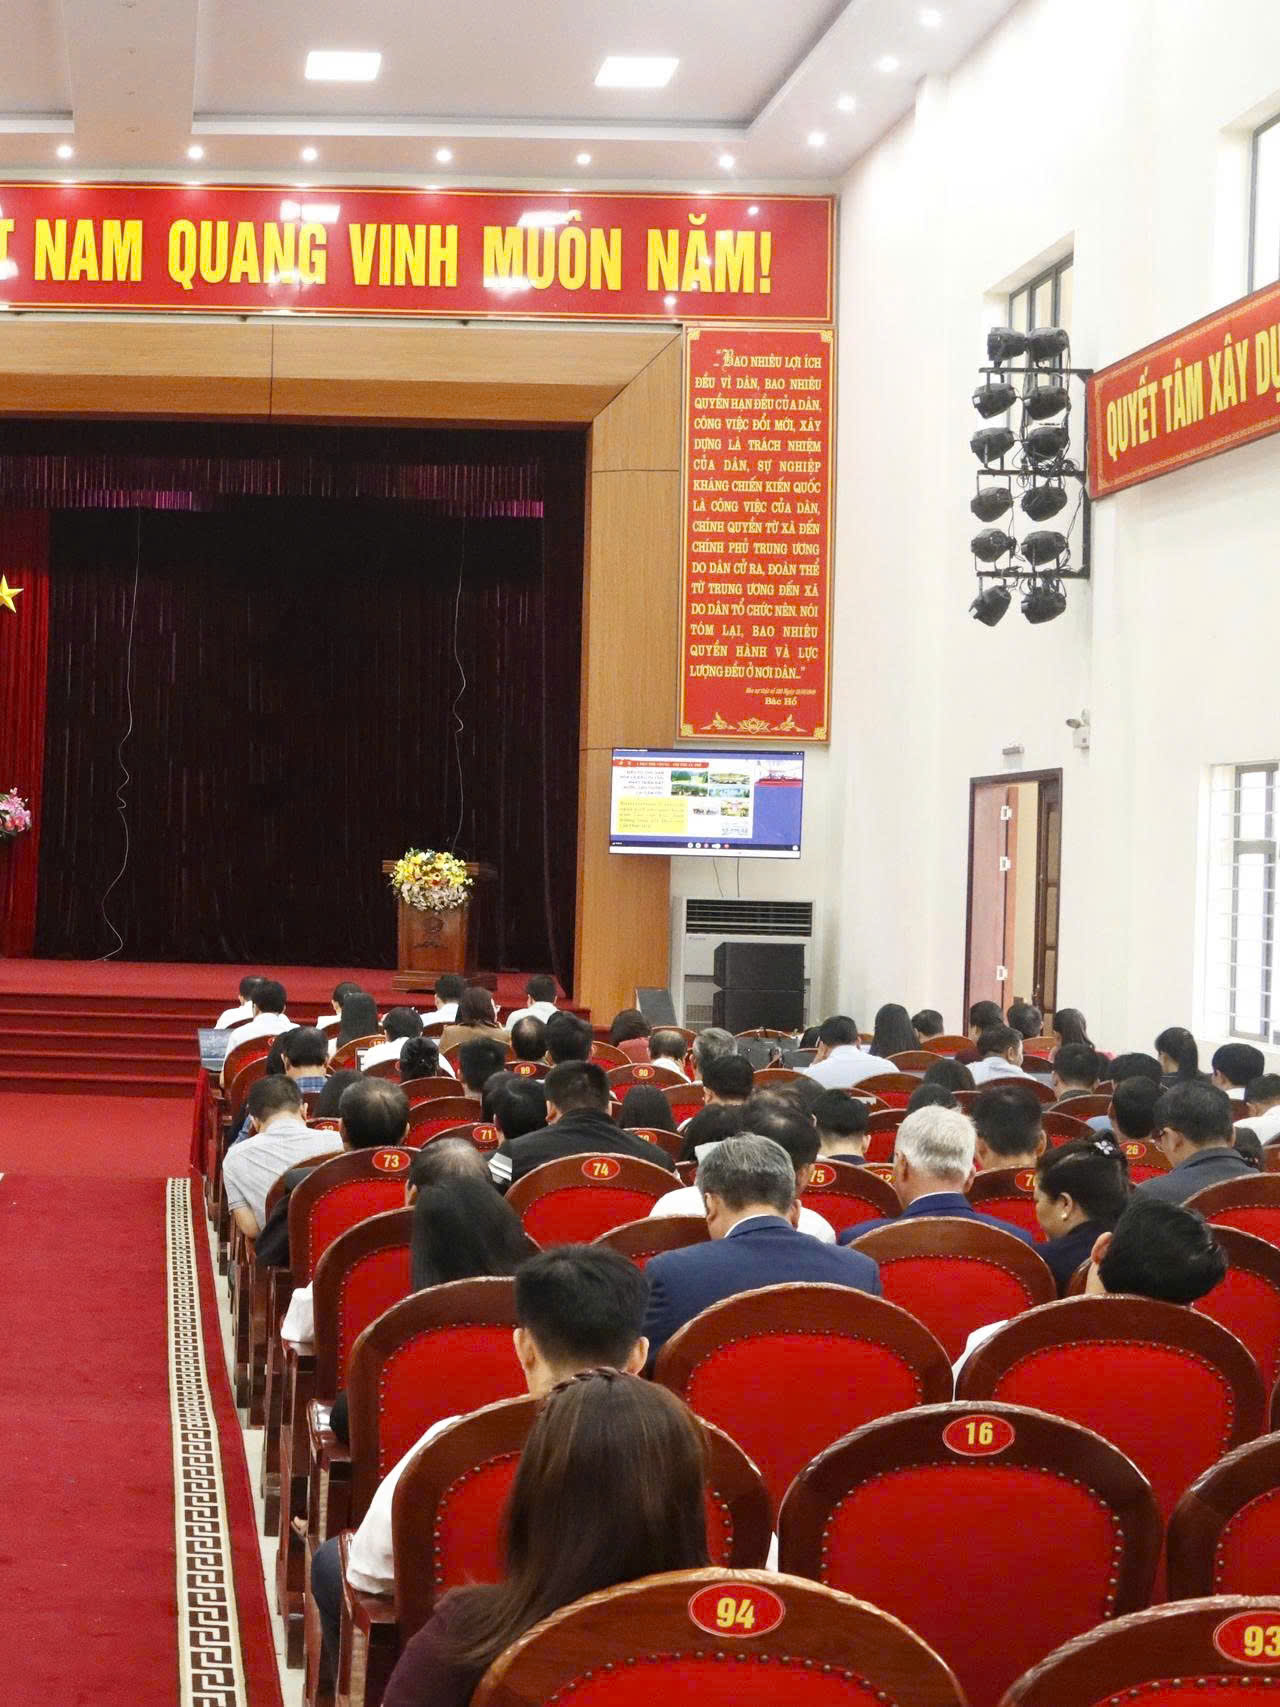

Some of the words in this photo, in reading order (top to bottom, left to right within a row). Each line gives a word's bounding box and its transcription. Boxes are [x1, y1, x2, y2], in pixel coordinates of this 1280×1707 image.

[34, 218, 143, 282] NAM
[167, 219, 327, 289] QUANG
[349, 222, 457, 287] VINH
[483, 209, 622, 291] MUÔN
[647, 213, 772, 293] NĂM!
[765, 379, 785, 389] BAO
[1107, 366, 1158, 462] QUYẾT
[1162, 357, 1204, 434] TÂM
[1208, 332, 1249, 416] XÂY
[753, 543, 788, 554] TRUNG
[692, 562, 706, 573] DO
[709, 583, 742, 594] TRUNG
[691, 604, 706, 615] DO
[752, 626, 775, 636] BAO
[480, 1129, 493, 1141] 71
[1125, 1145, 1138, 1156] 26
[383, 1153, 399, 1168] 73
[592, 1162, 609, 1176] 74
[809, 1170, 825, 1184] 75
[965, 1422, 993, 1447] 16
[716, 1597, 755, 1629] 94
[1244, 1625, 1280, 1656] 93
